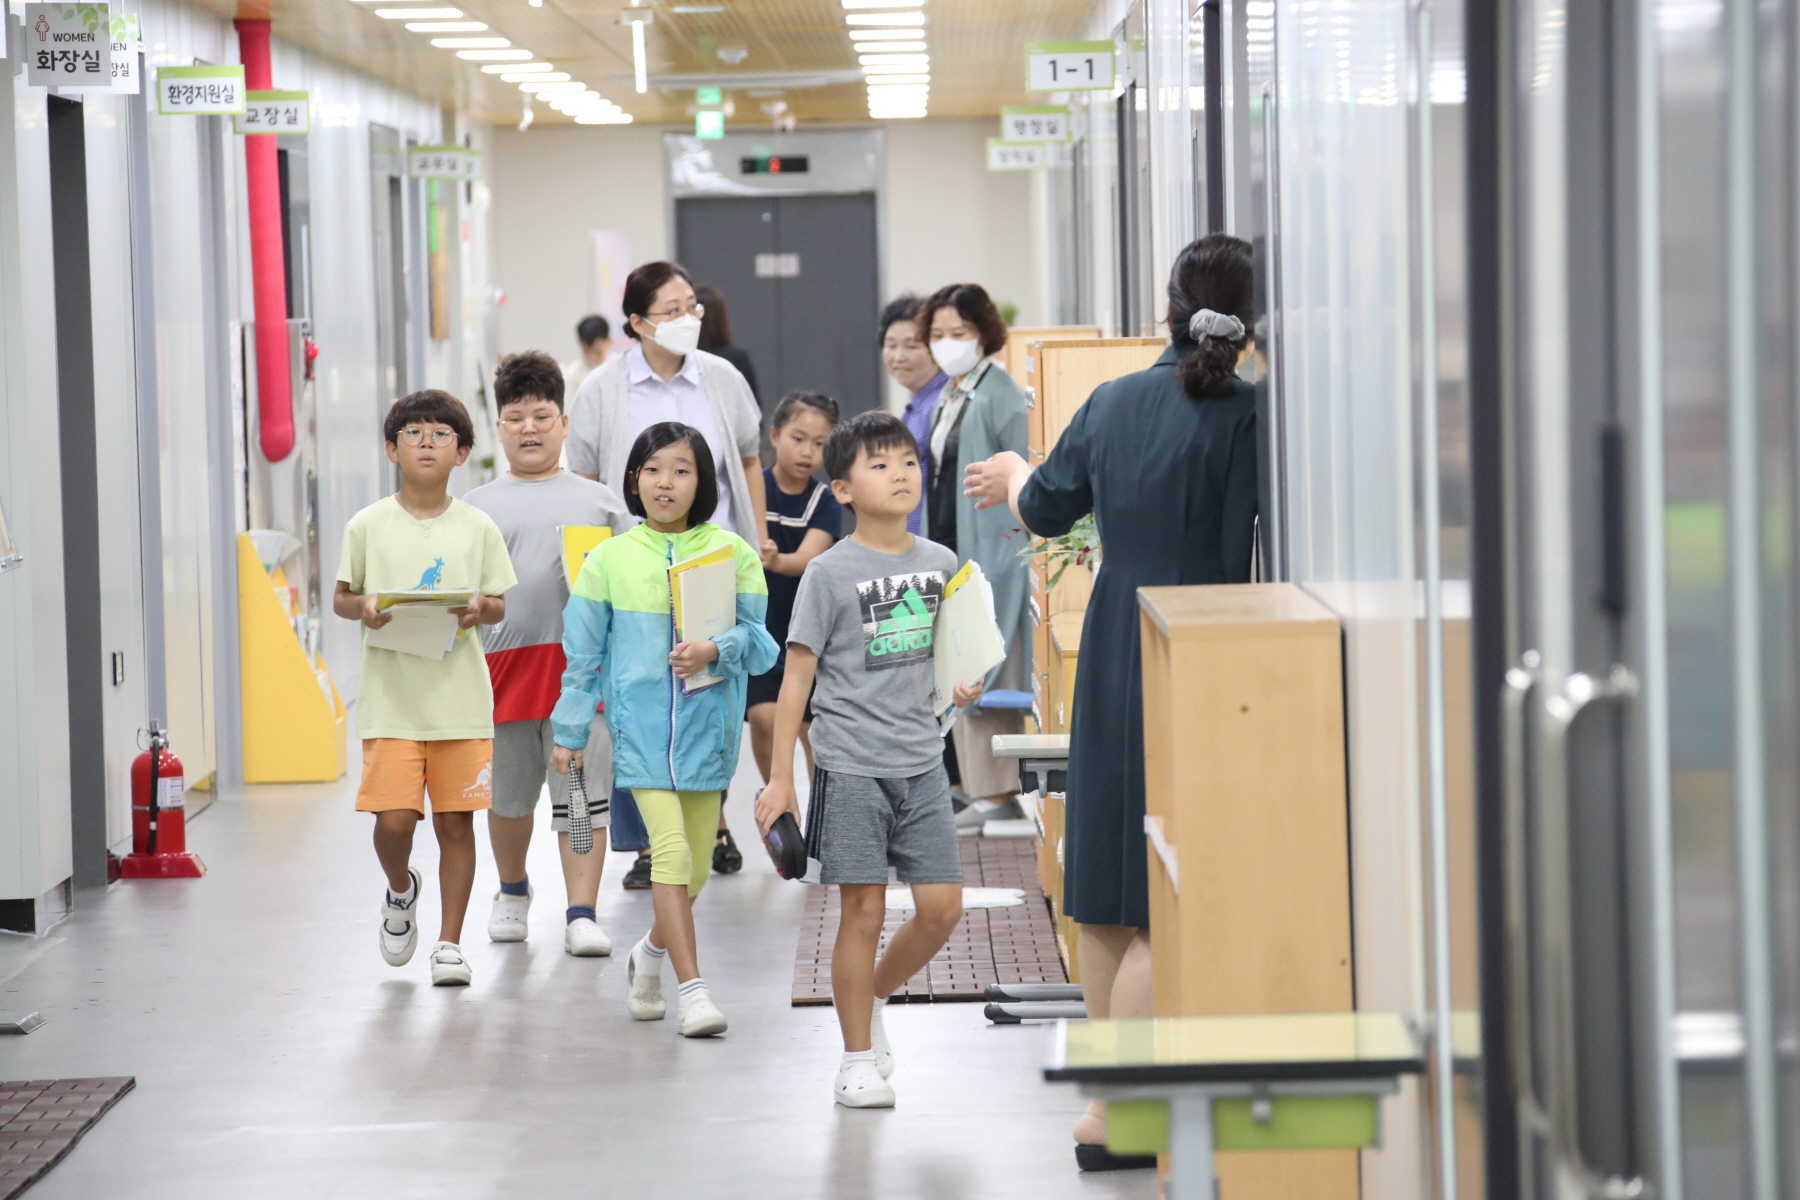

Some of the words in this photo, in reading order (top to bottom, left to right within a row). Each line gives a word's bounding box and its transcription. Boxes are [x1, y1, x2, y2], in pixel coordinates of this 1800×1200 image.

[53, 33, 95, 42] WOMEN
[37, 50, 101, 73] 화장실
[1048, 58, 1093, 81] 1-1
[168, 84, 235, 105] 환경지원실
